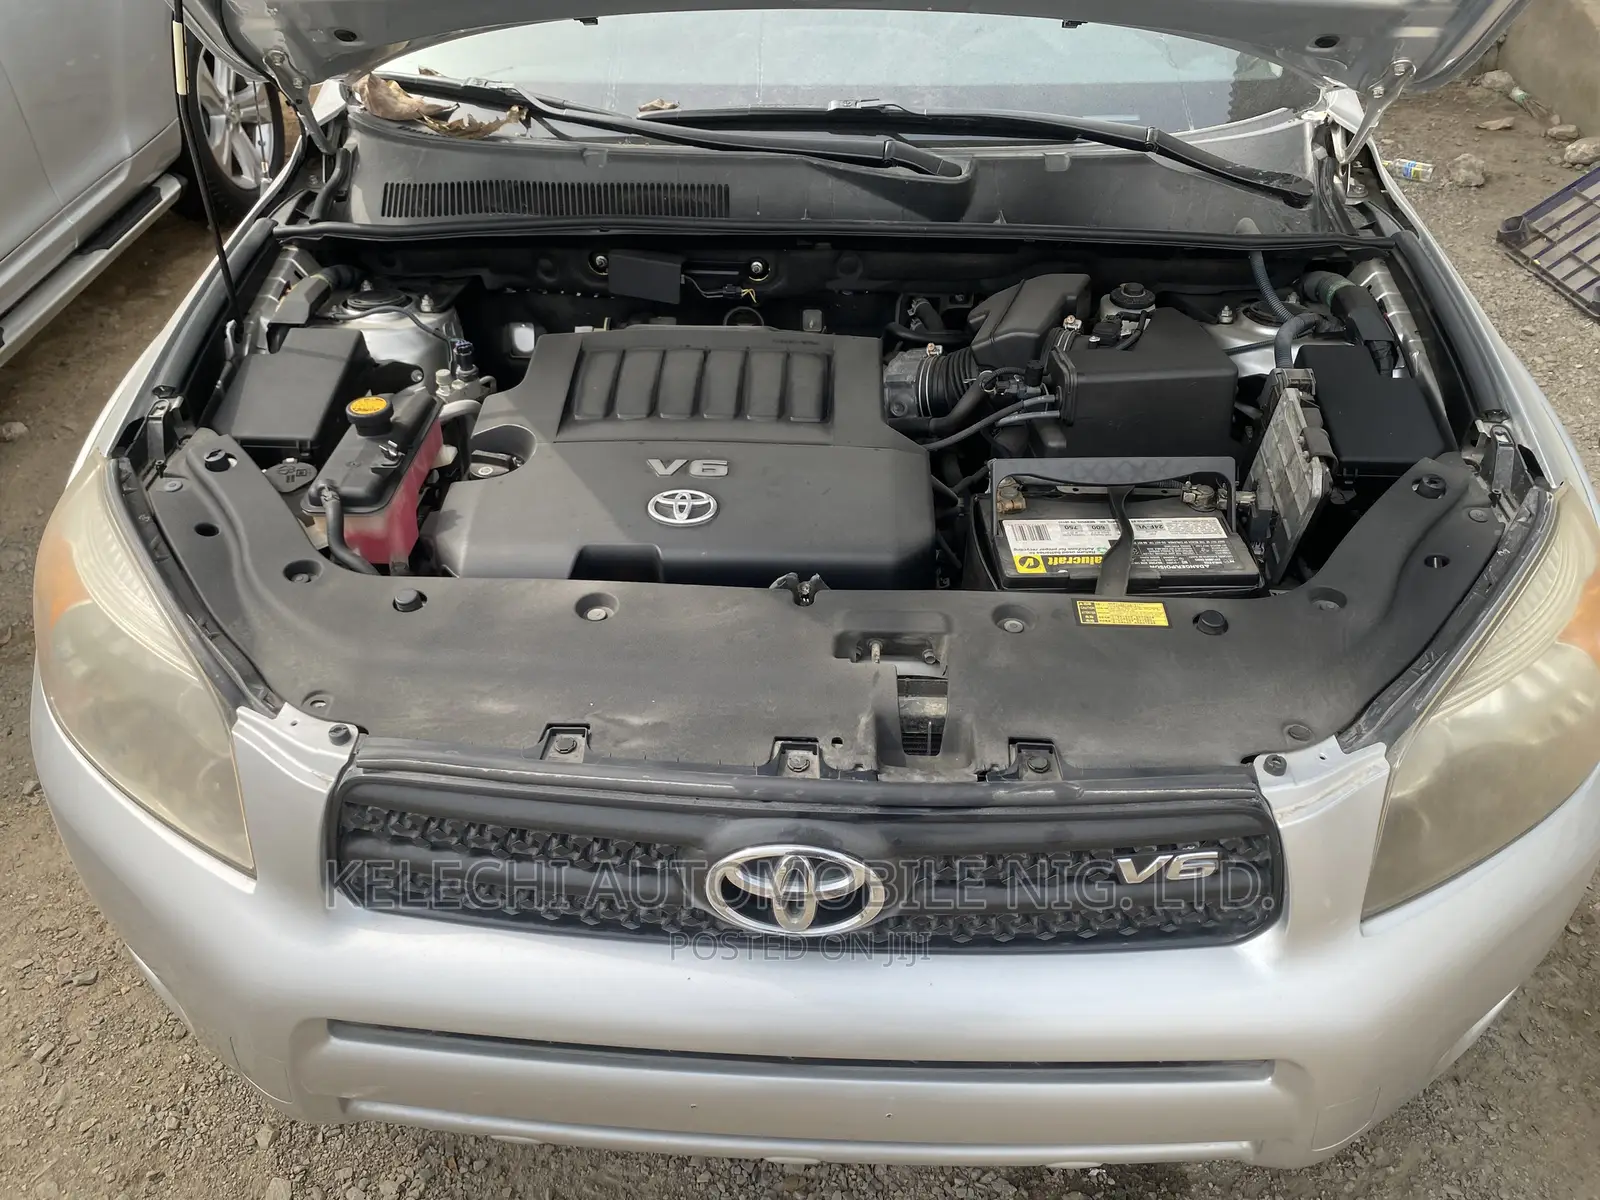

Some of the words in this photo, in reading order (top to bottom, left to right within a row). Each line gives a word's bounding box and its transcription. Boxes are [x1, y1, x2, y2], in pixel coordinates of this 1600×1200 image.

[646, 458, 729, 478] V6
[1047, 556, 1103, 566] alucraft
[1117, 851, 1218, 884] V6
